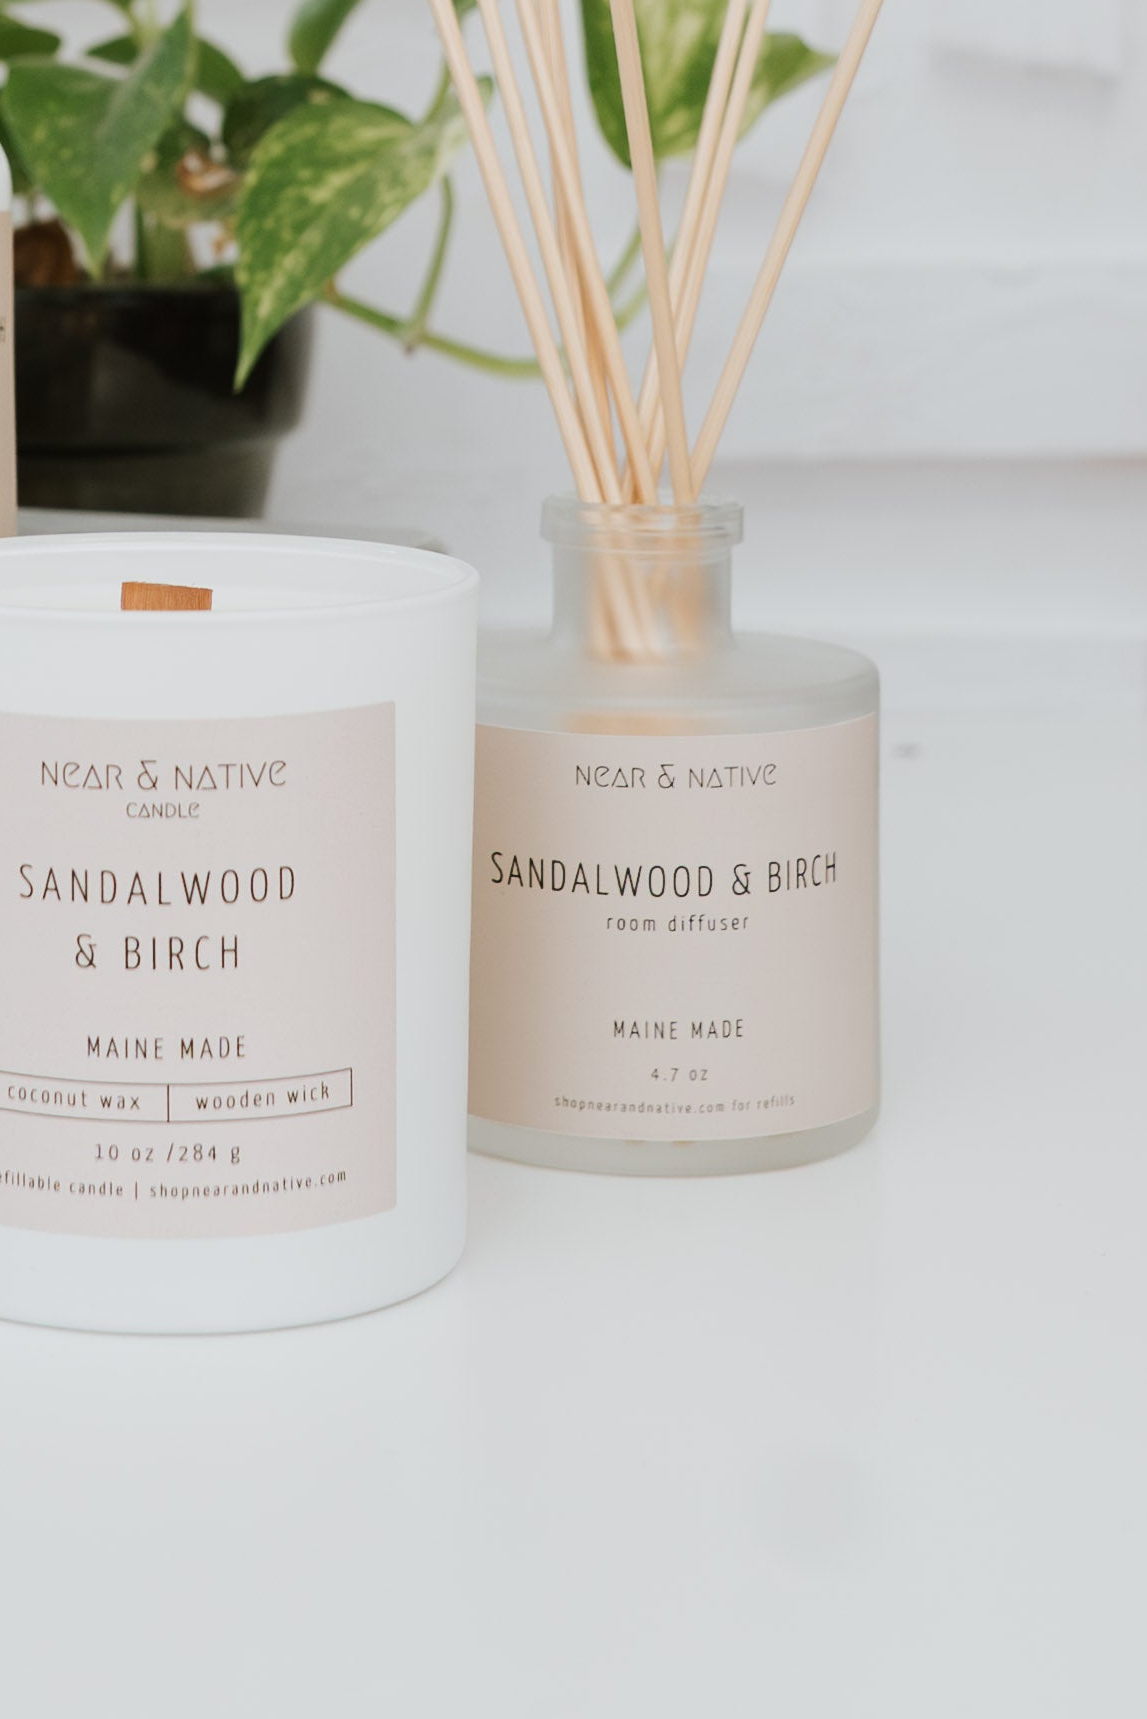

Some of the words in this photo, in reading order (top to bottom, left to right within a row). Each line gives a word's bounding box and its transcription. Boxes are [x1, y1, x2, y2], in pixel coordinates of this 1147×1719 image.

[41, 760, 124, 791] NEAR
[136, 759, 159, 791] &
[174, 759, 287, 791] NATIVE
[575, 764, 646, 789] NEAR
[657, 763, 676, 790] &
[688, 763, 777, 789] NATIVE
[125, 801, 200, 820] CANDLE
[19, 863, 295, 906] SANDALWOOD
[490, 851, 713, 898] SANDALWOOD
[731, 863, 752, 896] &
[768, 851, 836, 893] BIRCH
[606, 917, 656, 932] room
[667, 913, 749, 933] diffuser
[75, 933, 97, 969] &
[124, 935, 238, 971] BIRCH
[613, 1020, 678, 1041] MAINE
[691, 1018, 743, 1039] MADE
[87, 1035, 163, 1060] MAINE
[180, 1035, 246, 1060] MADE
[650, 1067, 680, 1083] 4.7
[688, 1068, 709, 1082] oz
[7, 1083, 89, 1109] coconut
[99, 1095, 140, 1110] wax
[195, 1089, 275, 1111] wooden
[286, 1080, 330, 1105] wick
[553, 1095, 727, 1115] shopnearandnative.com
[731, 1098, 751, 1112] for
[756, 1094, 796, 1110] refills
[95, 1143, 119, 1161] 10
[131, 1147, 154, 1163] oz
[166, 1142, 217, 1163] /284
[230, 1145, 241, 1166] g
[69, 1181, 123, 1197] candle
[149, 1170, 347, 1201] shopnearandnative.com
